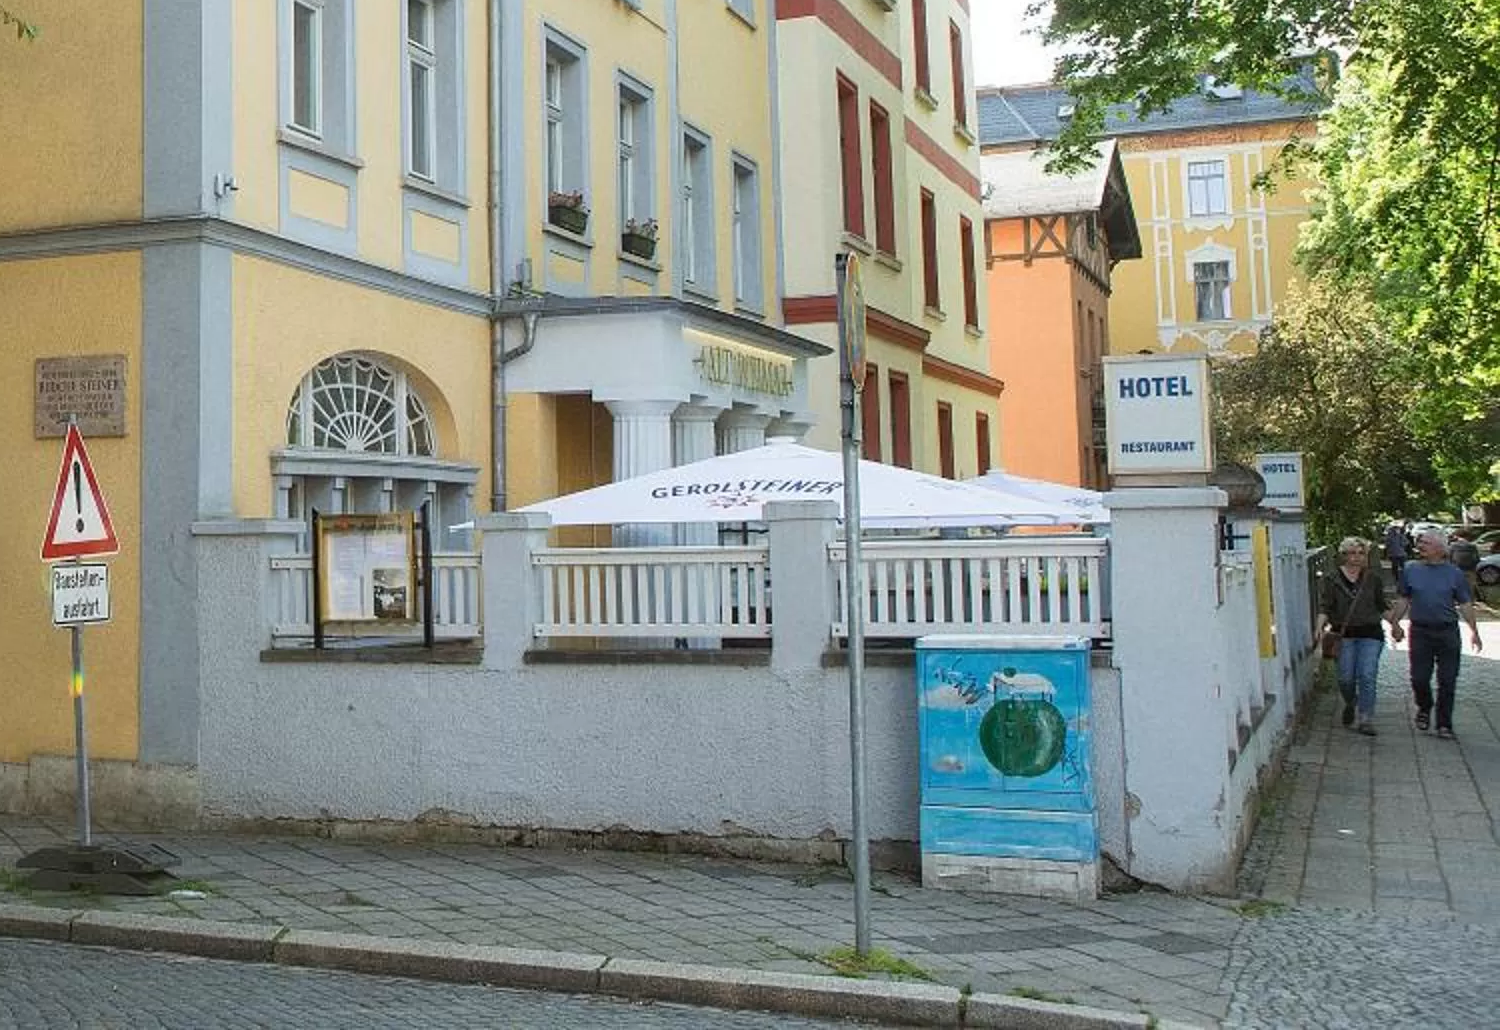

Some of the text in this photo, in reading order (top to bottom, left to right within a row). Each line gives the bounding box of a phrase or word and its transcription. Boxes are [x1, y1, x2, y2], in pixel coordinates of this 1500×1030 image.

[1119, 374, 1193, 399] HOTEL
[1120, 440, 1196, 454] RESTAURANT
[1262, 462, 1297, 474] HOTEL
[651, 479, 844, 499] GEROLSTEINER
[53, 569, 105, 590] Baustellen-
[63, 597, 101, 618] ausfahrt
